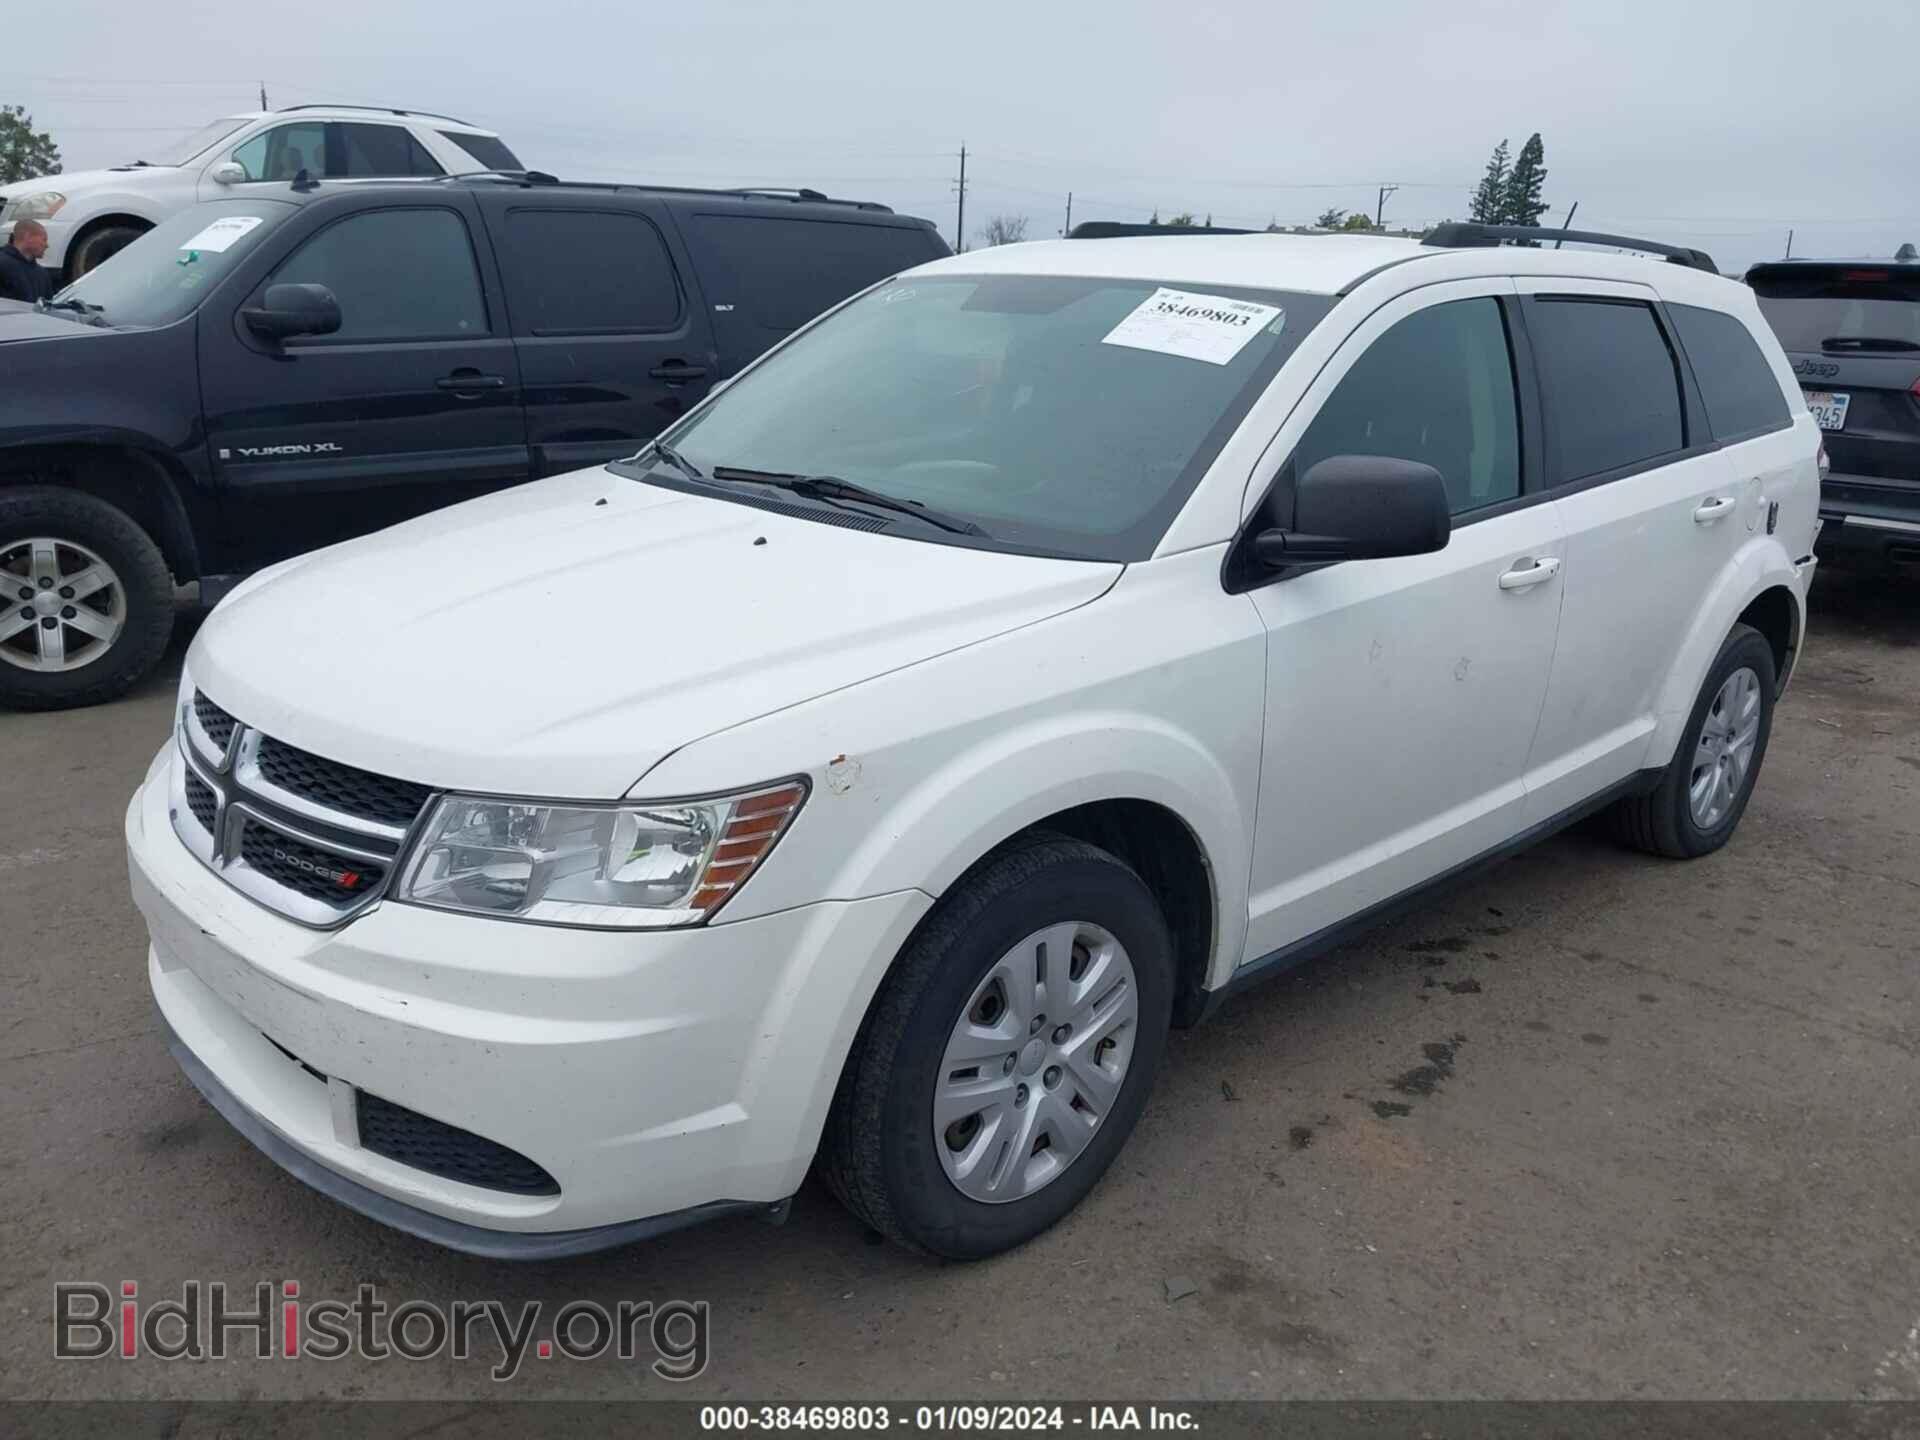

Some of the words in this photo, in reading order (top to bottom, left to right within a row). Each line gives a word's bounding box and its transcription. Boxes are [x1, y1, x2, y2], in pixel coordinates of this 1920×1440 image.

[1150, 302, 1251, 328] 38469803
[1794, 360, 1840, 378] Jeep
[238, 446, 310, 456] YUKON
[314, 443, 343, 453] XL
[274, 849, 345, 882] DODGE
